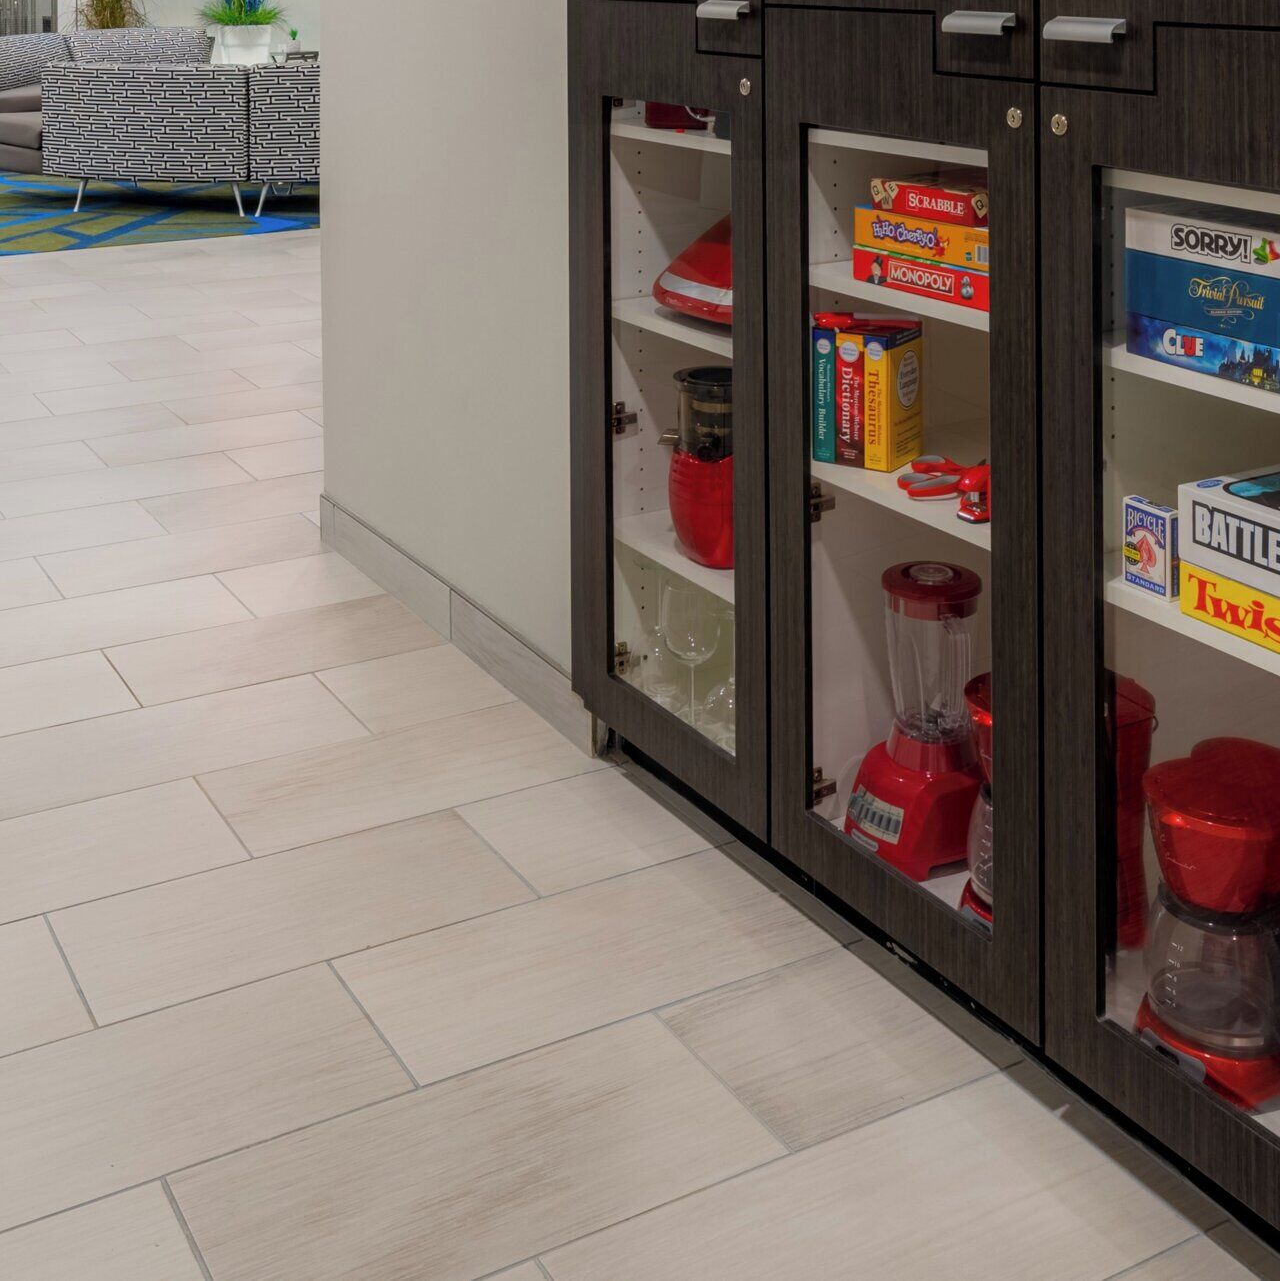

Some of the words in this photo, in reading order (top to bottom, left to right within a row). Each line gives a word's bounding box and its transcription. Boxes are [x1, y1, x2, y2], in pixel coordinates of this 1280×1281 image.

[908, 193, 964, 215] SCRABBLE
[1173, 225, 1249, 260] SORRY!
[890, 267, 952, 291] MONOPOLY
[1189, 276, 1231, 302] Trivial
[1225, 280, 1265, 311] Pursuit
[1162, 328, 1203, 357] CLUE
[818, 358, 826, 406] Vocabulary
[839, 367, 853, 442] Dictionary
[868, 370, 879, 445] Thesaurus
[818, 408, 826, 440] Builder
[1126, 507, 1165, 546] BICYCLE
[1126, 571, 1165, 594] STANDARD
